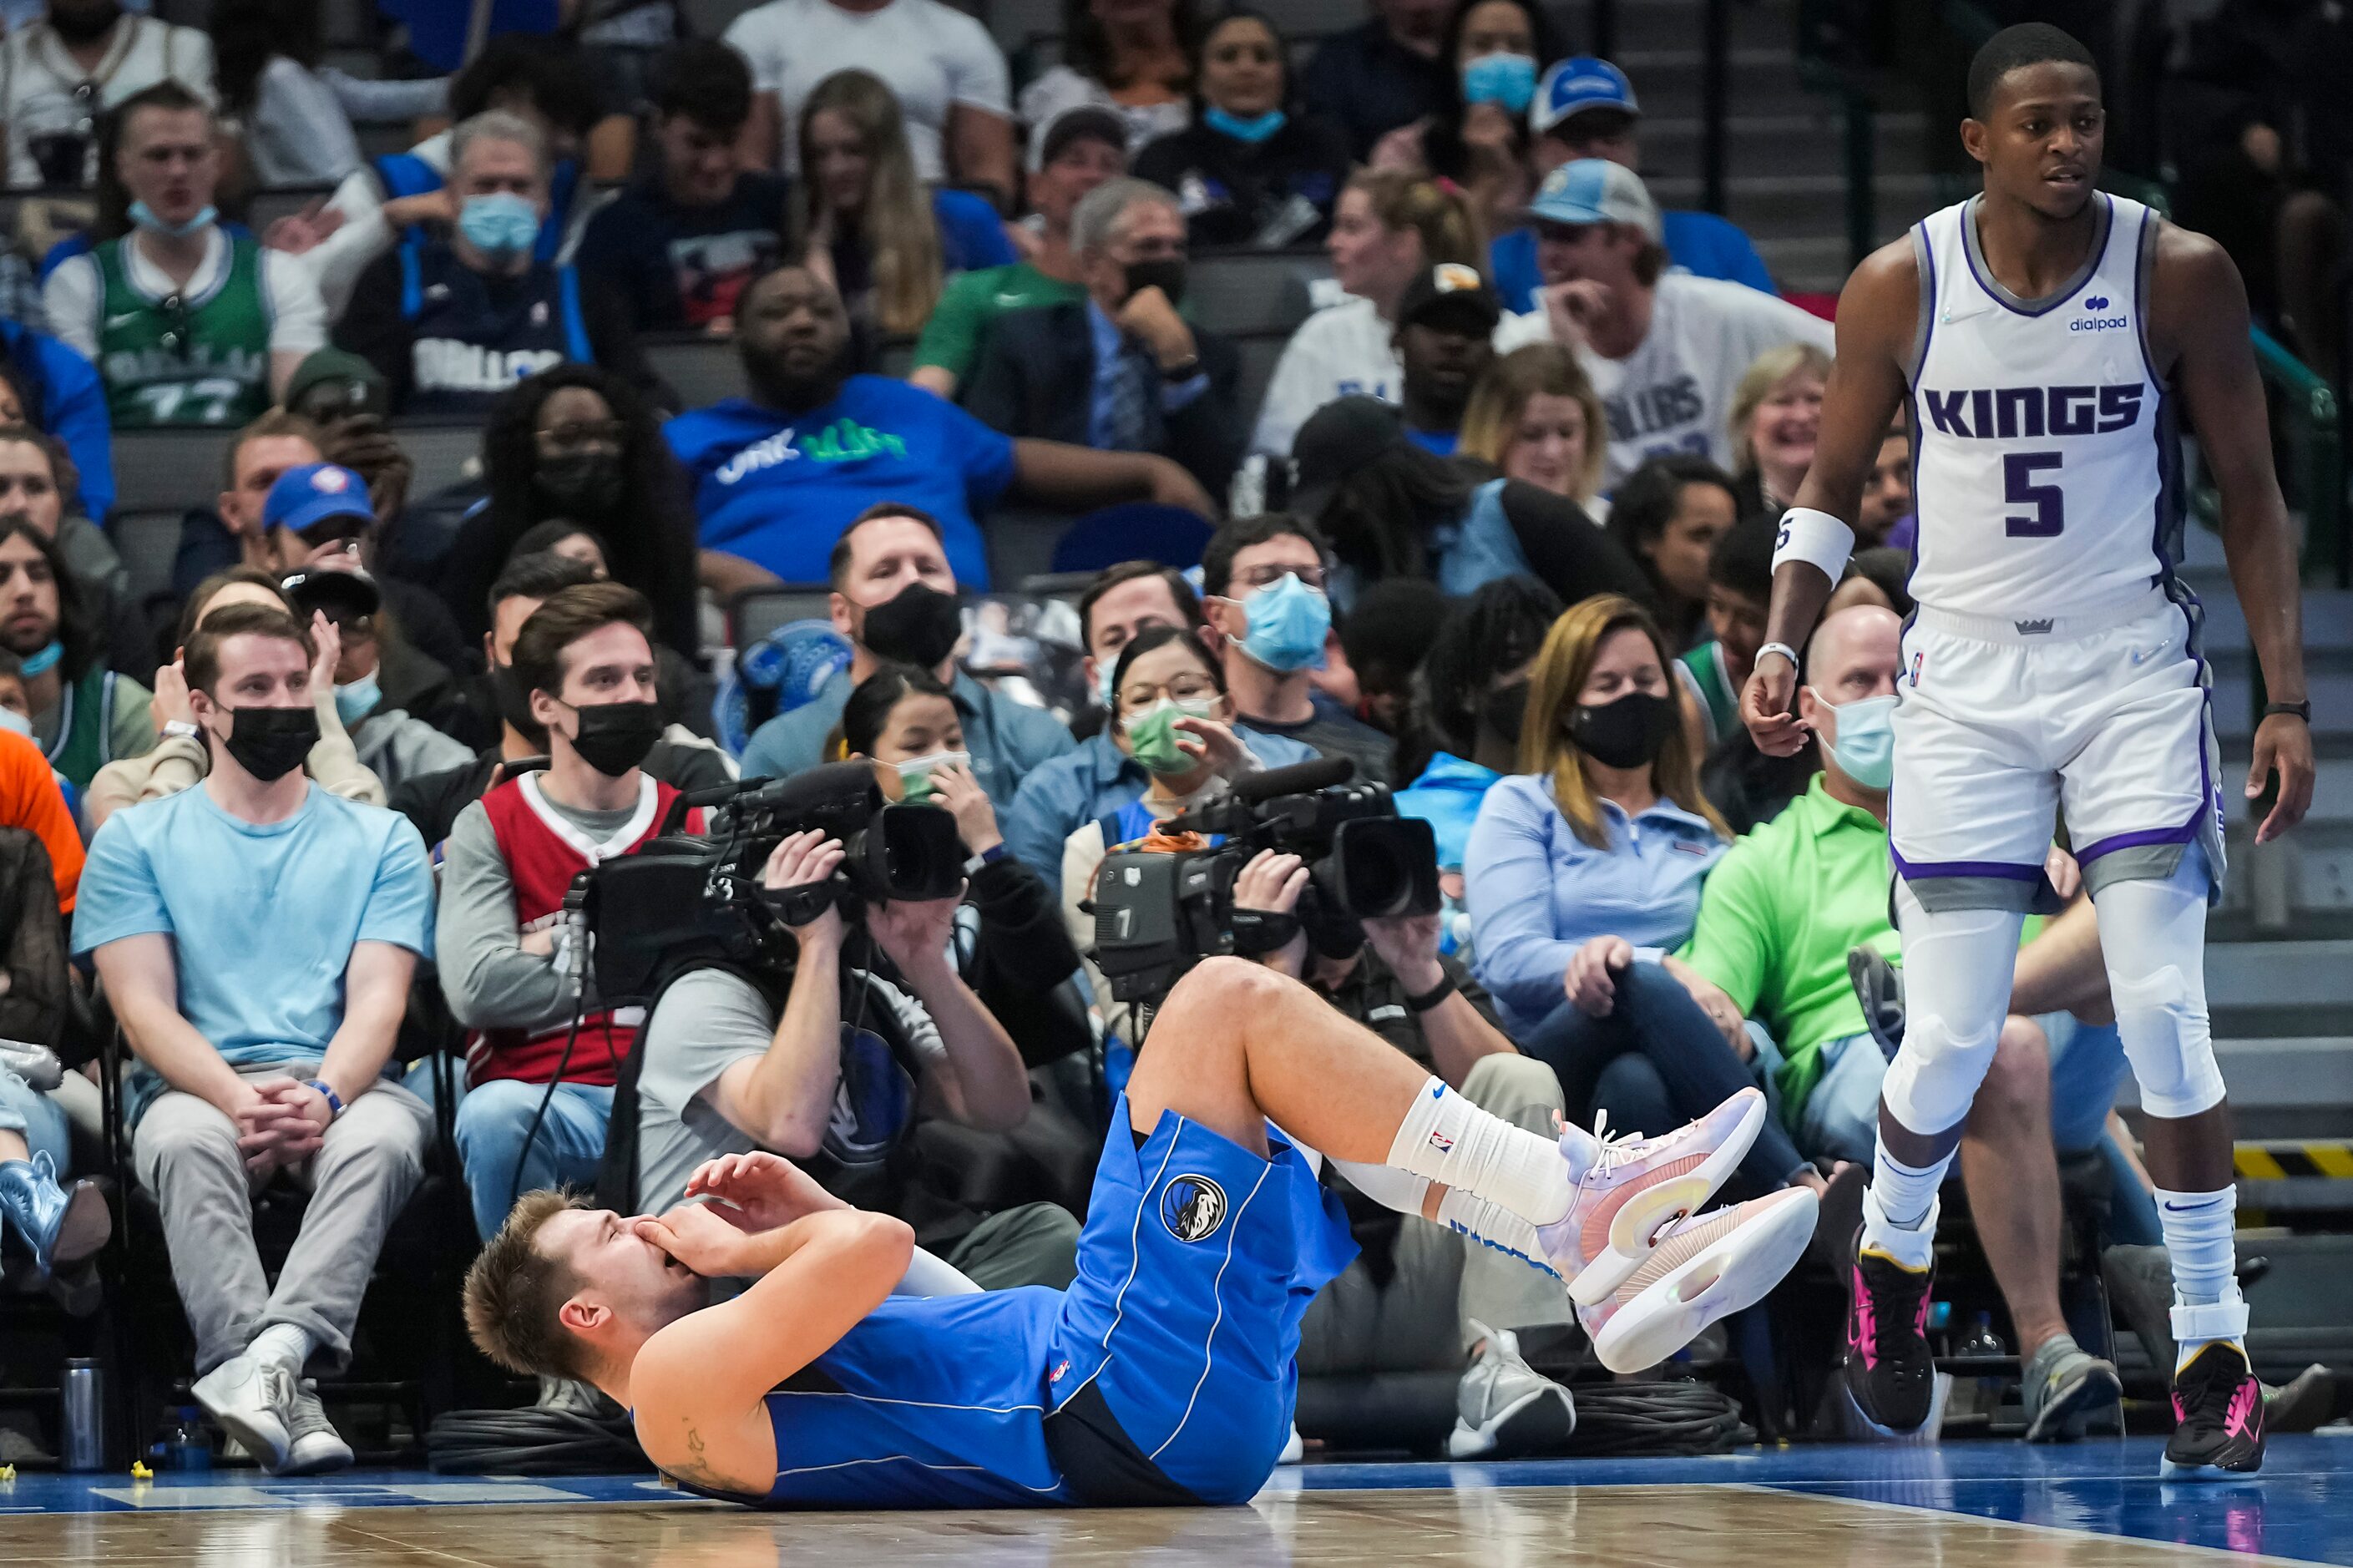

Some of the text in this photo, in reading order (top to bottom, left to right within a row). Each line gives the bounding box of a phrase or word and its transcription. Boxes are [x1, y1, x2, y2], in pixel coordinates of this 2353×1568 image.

[2070, 315, 2127, 332] dialpad
[1923, 382, 2145, 438] KINGS
[2003, 451, 2064, 537] 5
